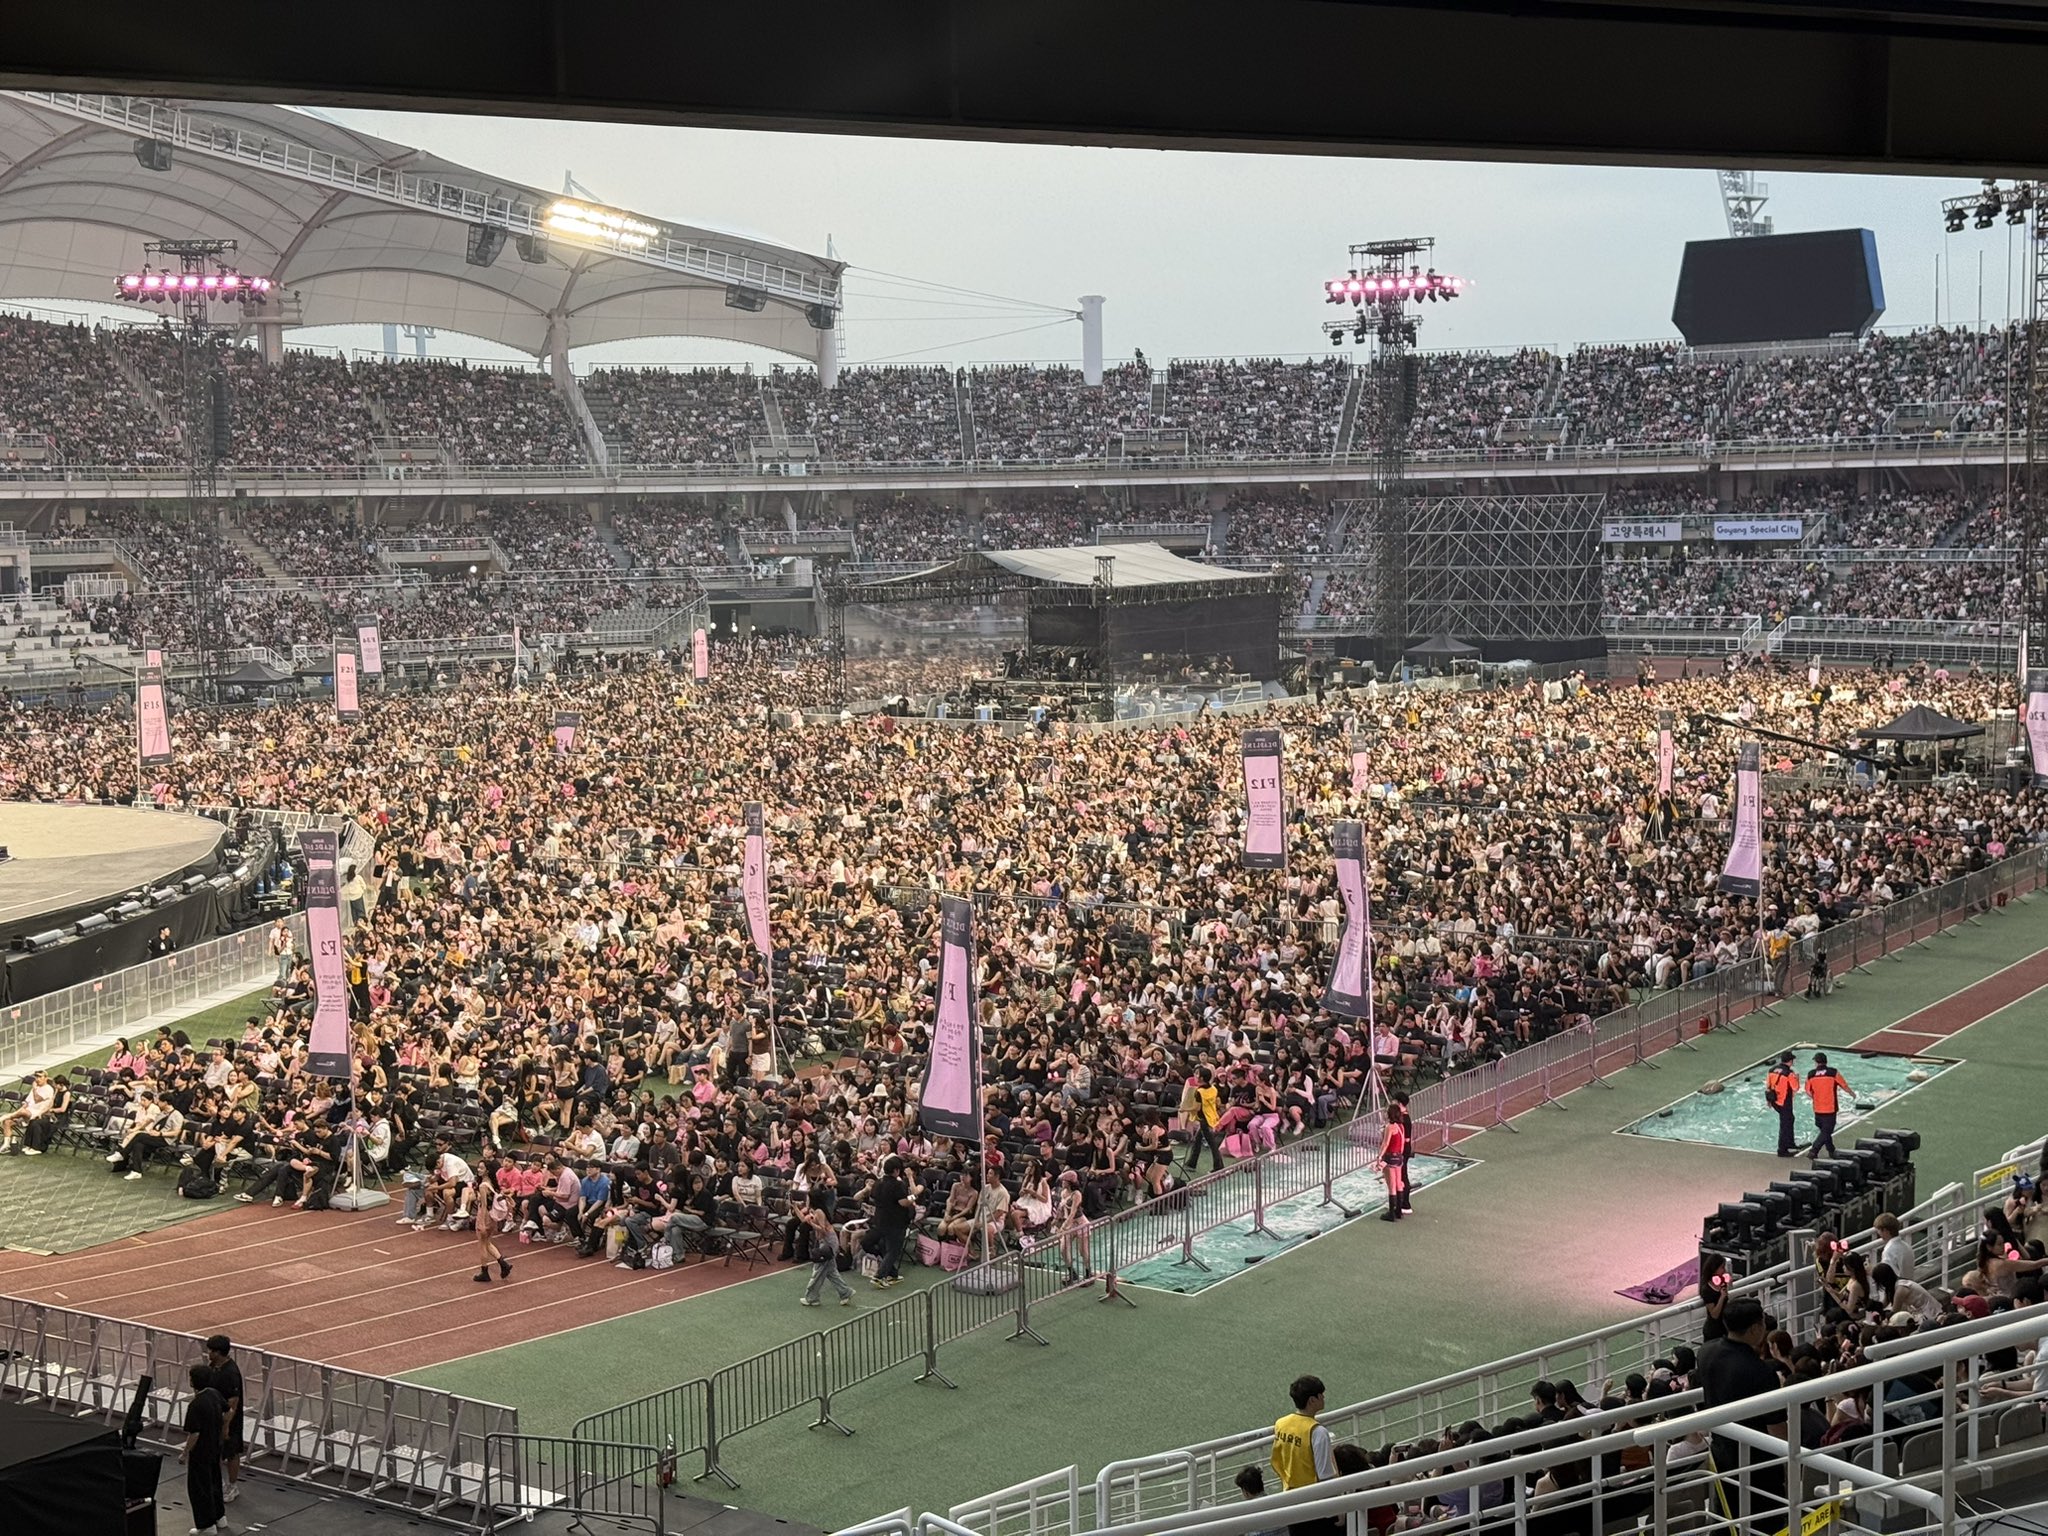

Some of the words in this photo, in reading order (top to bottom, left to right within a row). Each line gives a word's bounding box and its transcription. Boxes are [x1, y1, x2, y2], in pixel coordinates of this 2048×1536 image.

[1610, 525, 1666, 538] 고양특례시
[1716, 525, 1747, 535] Goyang
[1750, 524, 1778, 534] Special
[1780, 524, 1799, 534] City
[1815, 1505, 1835, 1525] AREA
